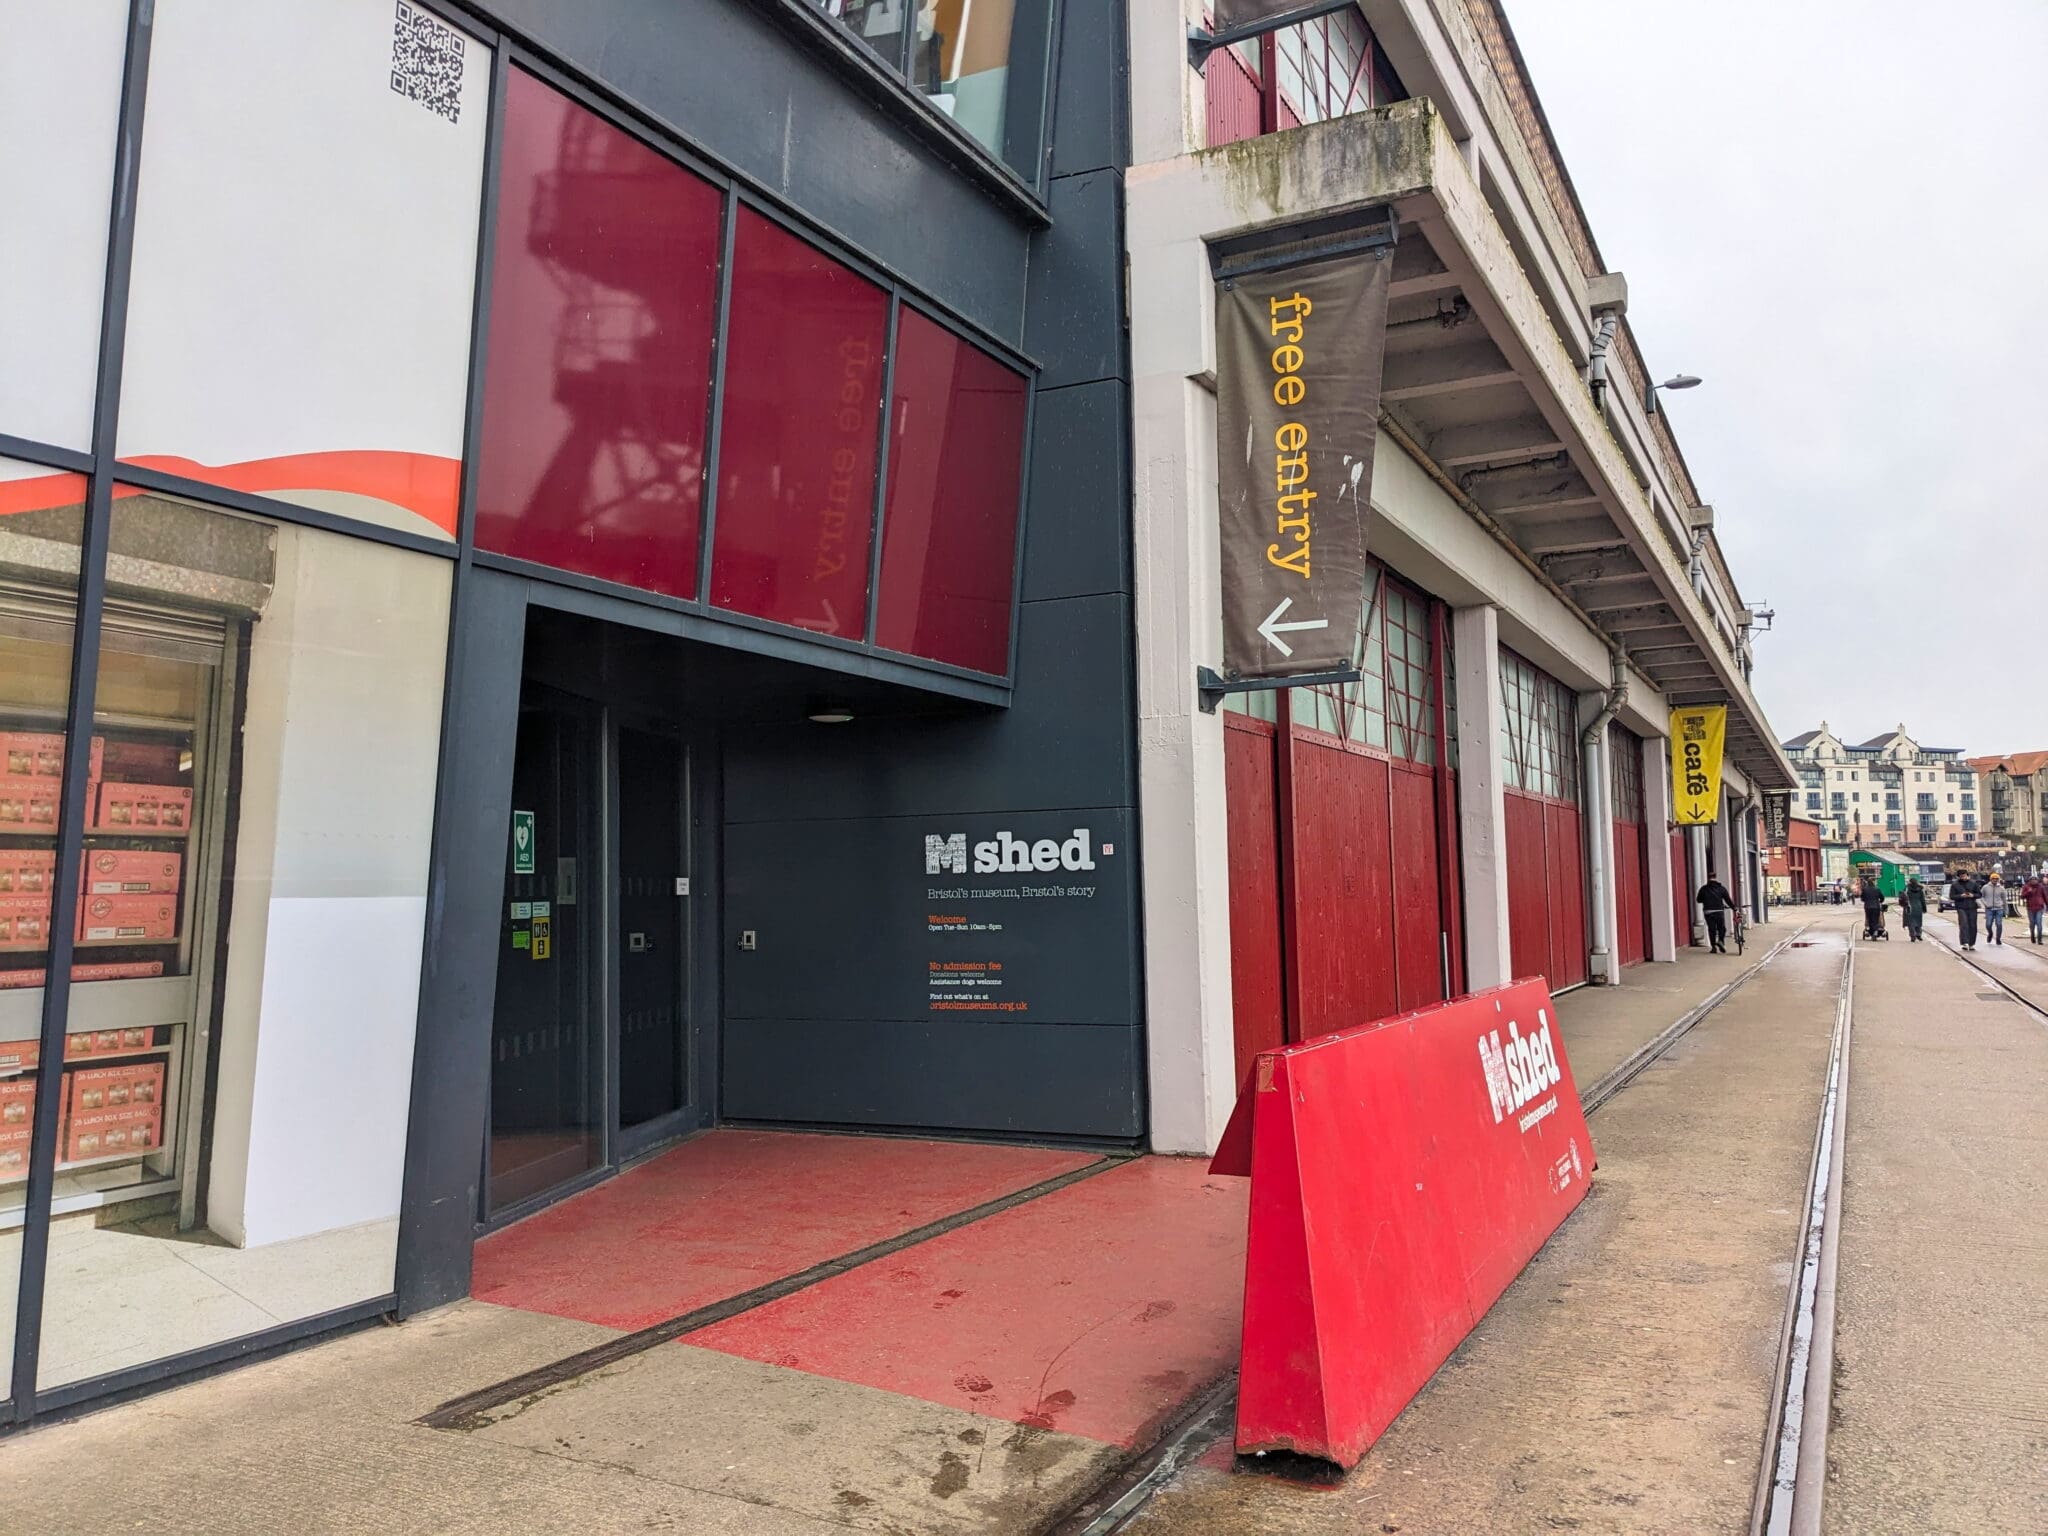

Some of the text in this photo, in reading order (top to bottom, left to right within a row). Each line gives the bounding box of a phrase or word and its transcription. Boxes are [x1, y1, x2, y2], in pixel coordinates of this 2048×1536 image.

[1266, 291, 1318, 579] free entry
[1684, 743, 1709, 796] café
[1773, 807, 1786, 838] shed
[925, 828, 1096, 875] M shed
[927, 885, 1096, 900] Bristol's museum, Bristol's story
[928, 914, 967, 924] Welcome
[928, 924, 943, 932] Open
[929, 961, 1002, 971] No admission fee
[976, 978, 1002, 986] welcome
[1505, 1008, 1561, 1109] shed
